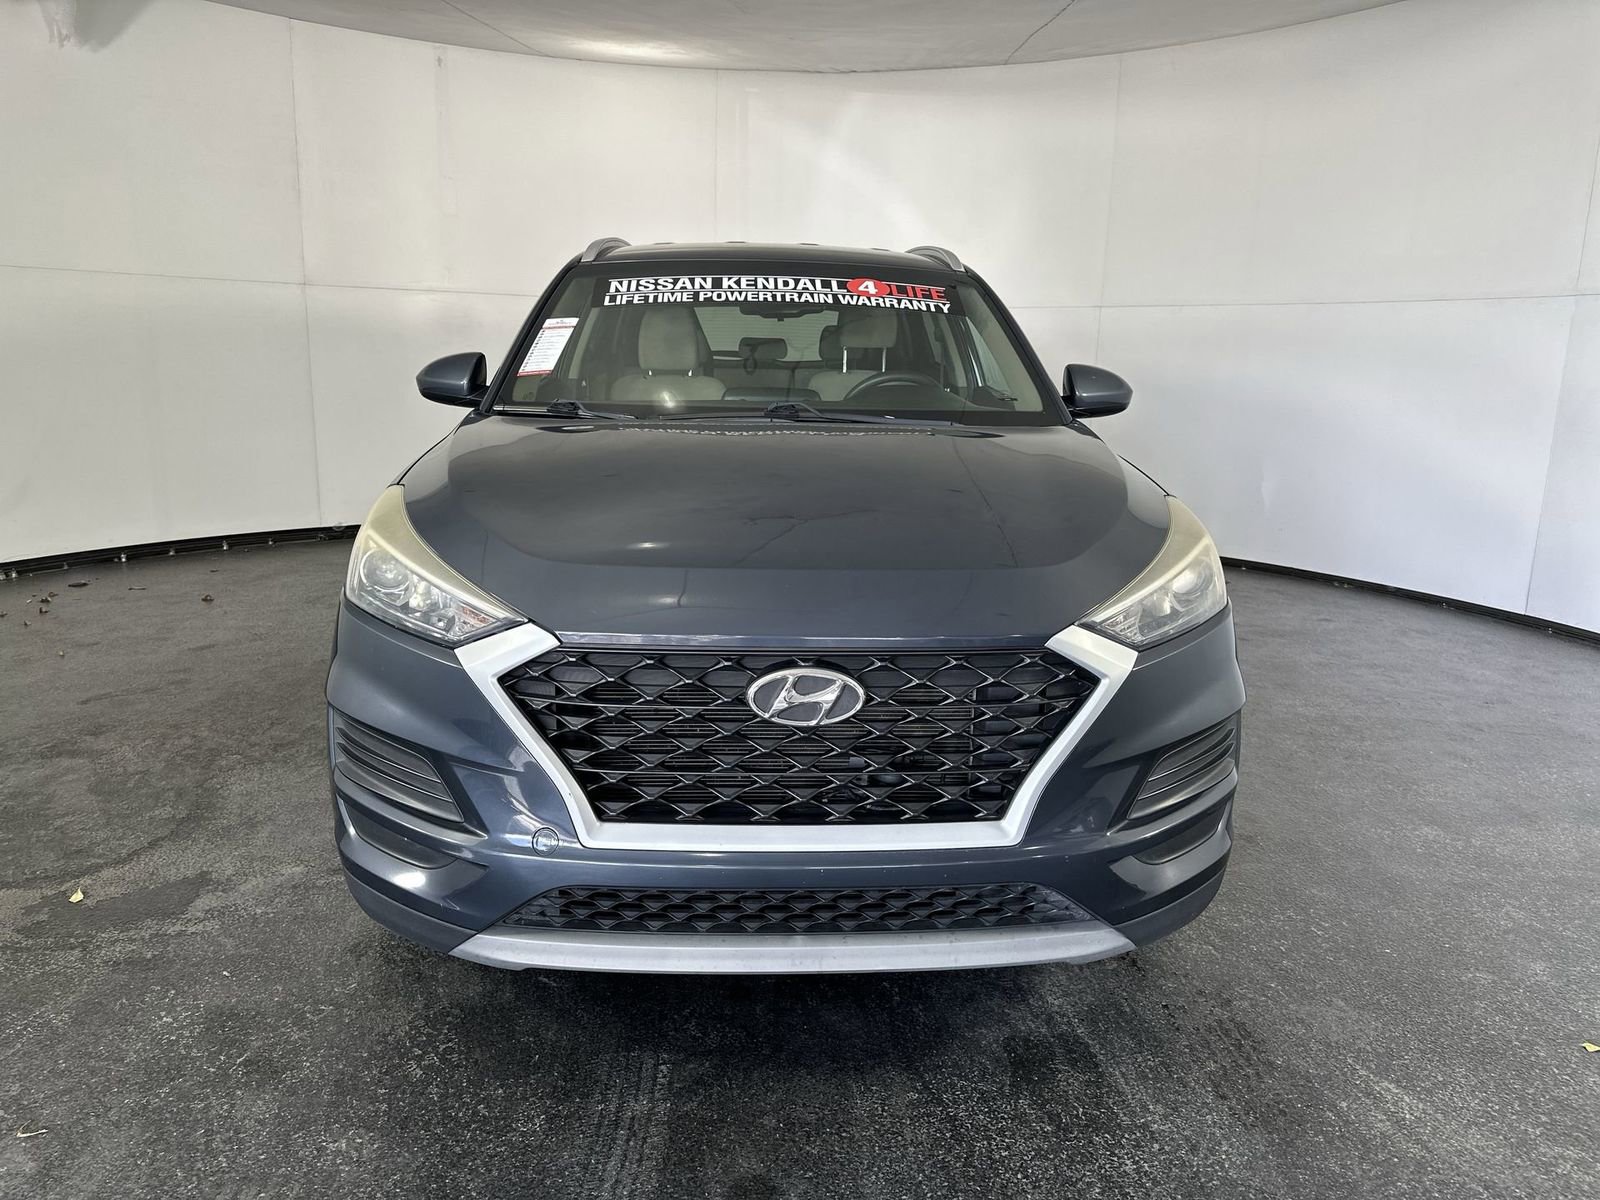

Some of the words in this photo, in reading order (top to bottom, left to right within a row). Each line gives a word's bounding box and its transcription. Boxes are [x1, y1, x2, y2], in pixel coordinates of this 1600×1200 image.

[609, 277, 713, 293] NISSAN
[722, 277, 847, 293] KENDALL
[858, 280, 878, 294] 4
[890, 284, 947, 301] LIFE
[603, 292, 694, 306] LIFETIME
[699, 291, 834, 304] POWERTRAIN
[837, 294, 951, 314] WARRANTY
